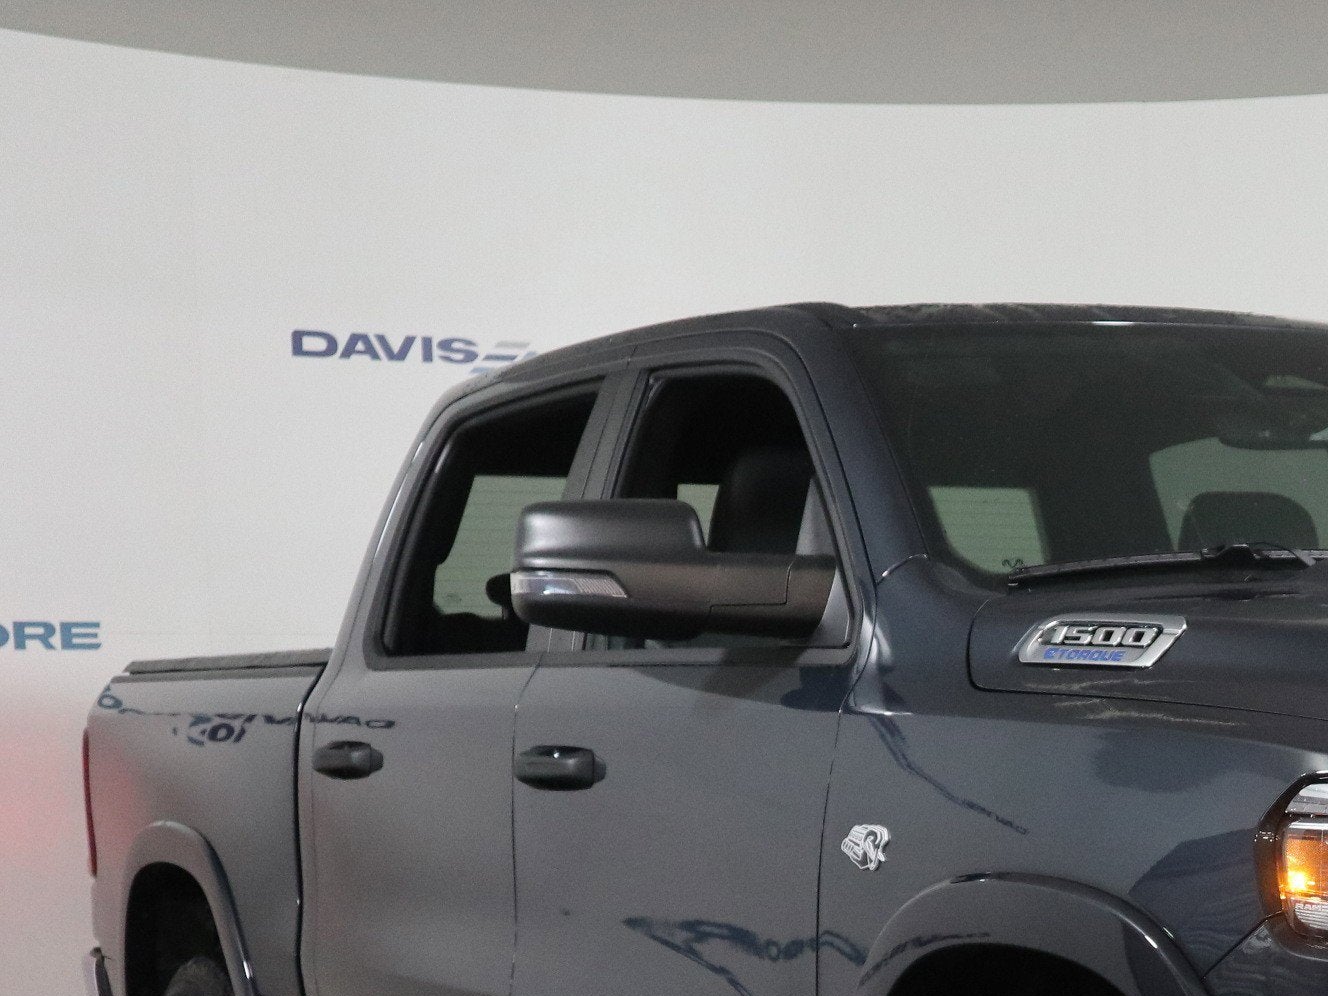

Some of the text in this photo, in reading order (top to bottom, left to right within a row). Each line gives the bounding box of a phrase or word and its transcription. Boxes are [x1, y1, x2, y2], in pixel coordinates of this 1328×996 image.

[291, 329, 480, 364] DAVIS
[0, 621, 102, 650] RE
[1038, 625, 1161, 648] 1500
